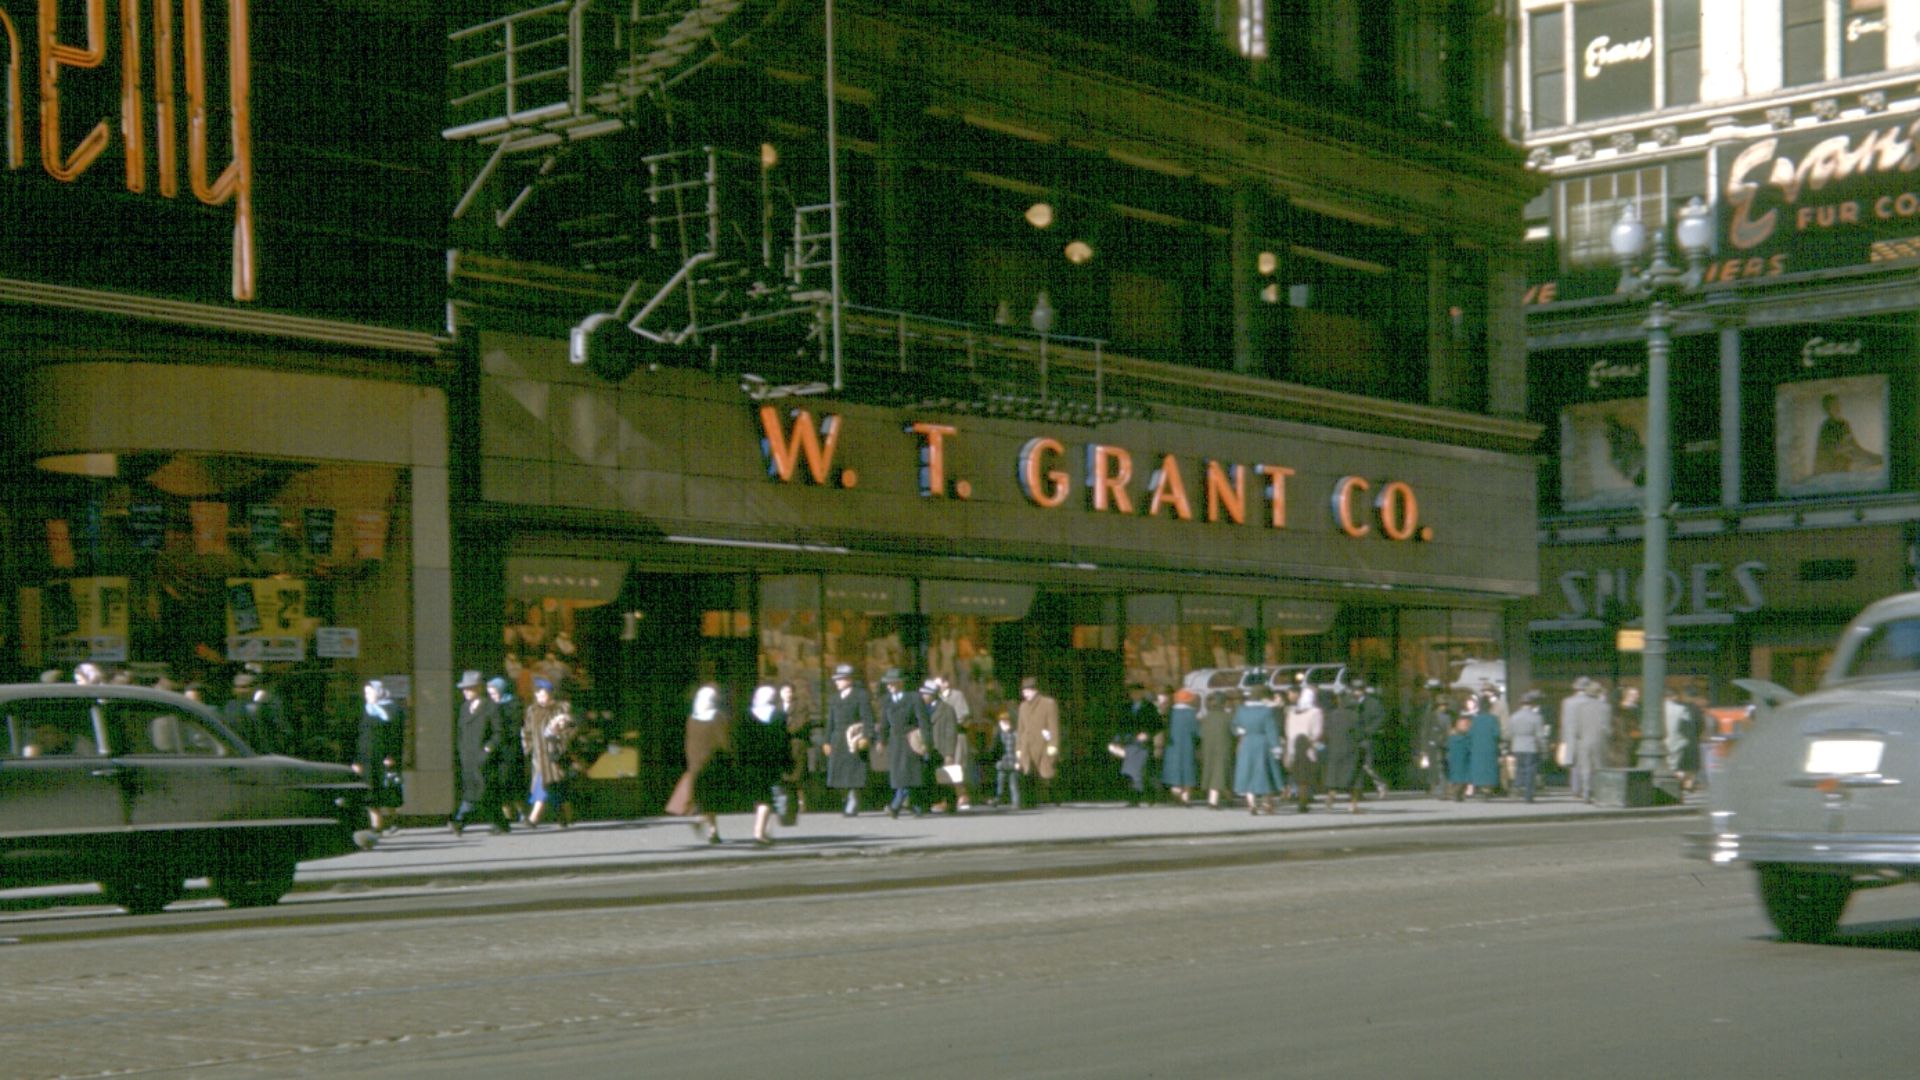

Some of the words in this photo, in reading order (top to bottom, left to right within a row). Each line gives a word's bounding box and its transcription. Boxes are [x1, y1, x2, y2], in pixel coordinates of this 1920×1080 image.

[1584, 35, 1652, 79] Evans
[0, 0, 254, 300] elly
[1796, 201, 1859, 230] FUR
[760, 405, 857, 488] W.
[904, 422, 972, 499] T.
[1018, 436, 1296, 528] GRANT
[1331, 475, 1434, 541] CO.
